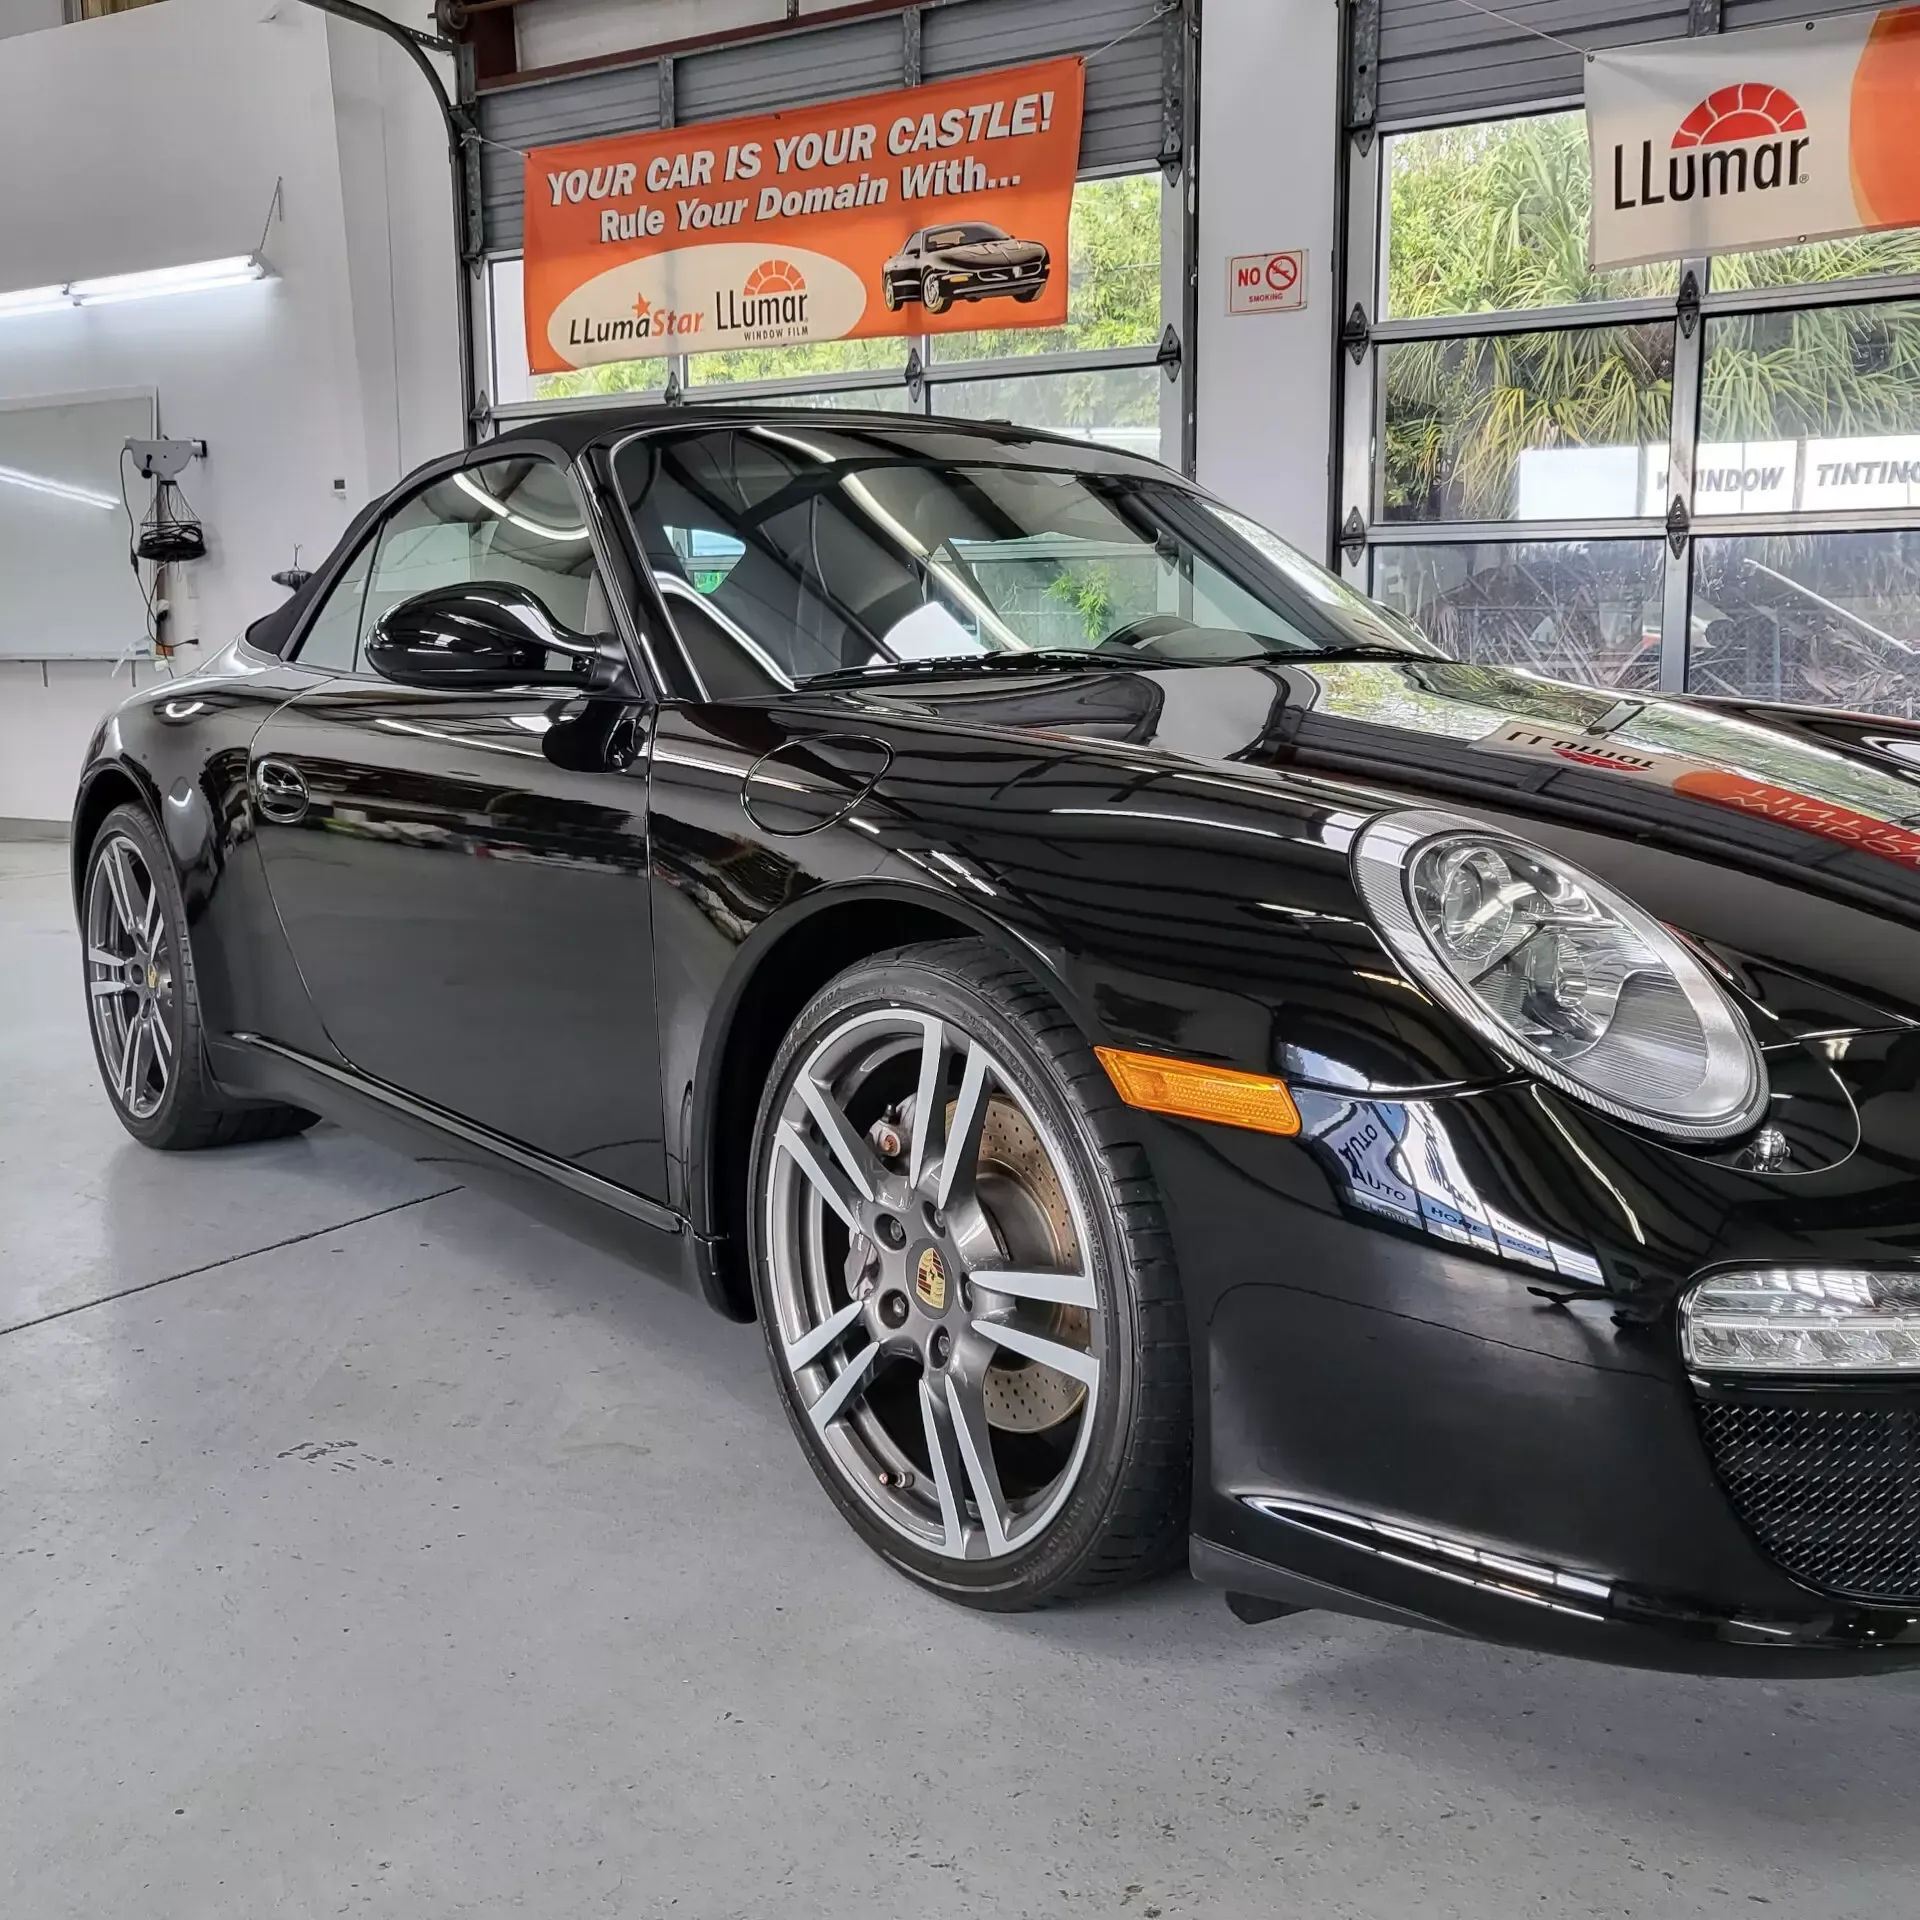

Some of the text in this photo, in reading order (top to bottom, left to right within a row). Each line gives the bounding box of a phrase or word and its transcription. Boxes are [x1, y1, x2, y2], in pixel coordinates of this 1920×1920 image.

[547, 91, 1055, 206] YOUR CAR IS YOUR CASTLE!
[600, 156, 1021, 243] Rule Your Domain With...
[1237, 267, 1261, 287] NO
[1248, 292, 1284, 303] SMOKING
[569, 307, 704, 346] LLumaStar
[744, 325, 809, 342] WINDOW FILM
[1351, 1162, 1407, 1201] AUTO
